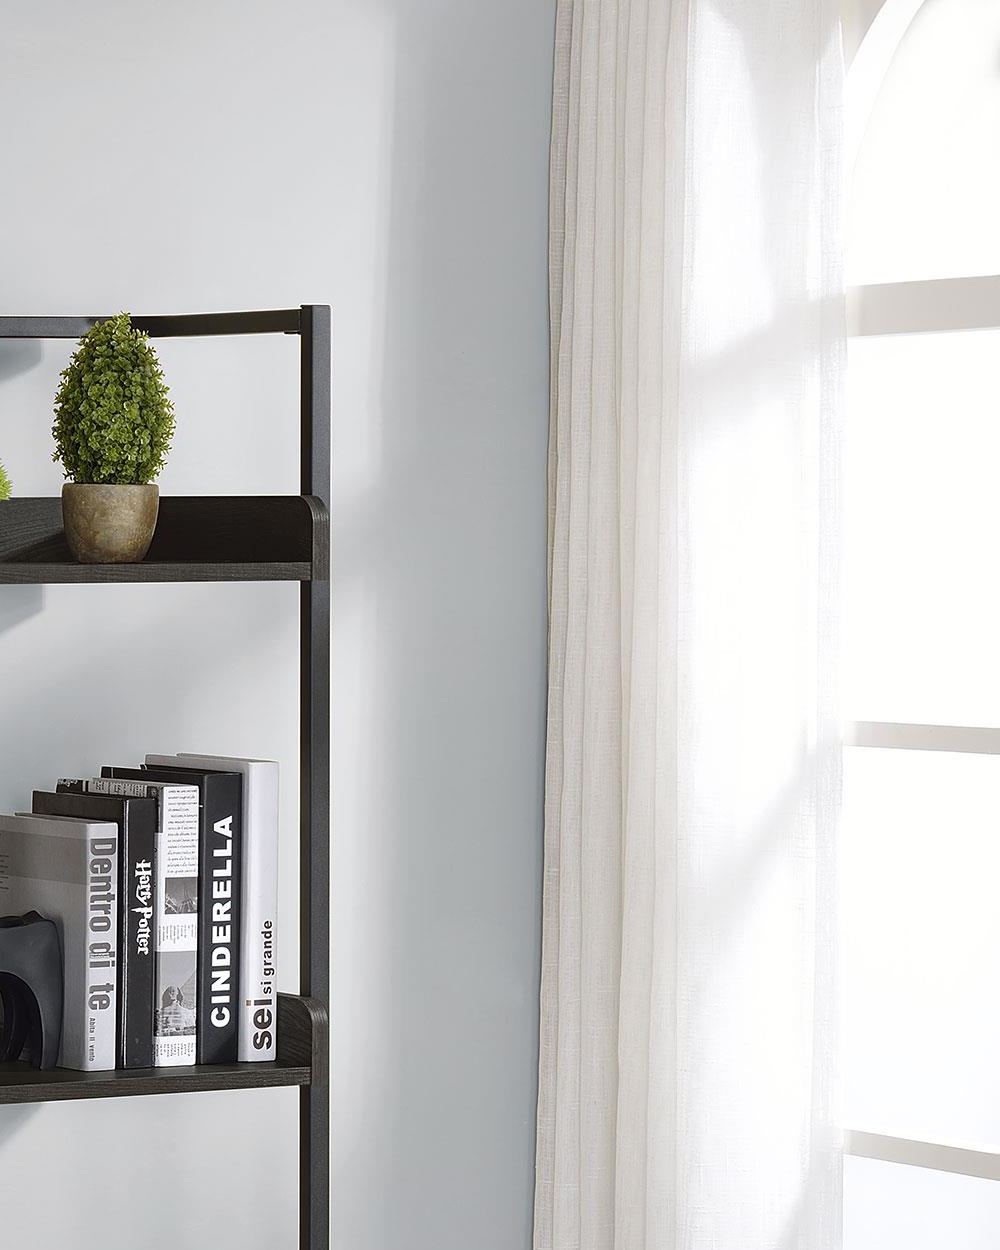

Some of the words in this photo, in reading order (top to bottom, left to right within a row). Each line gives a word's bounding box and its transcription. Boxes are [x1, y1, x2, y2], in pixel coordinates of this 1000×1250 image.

[89, 838, 116, 932] Dentro
[135, 859, 152, 905] Harry
[131, 905, 153, 955] Potter
[211, 815, 233, 1029] CINDERELLA
[88, 942, 115, 968] di
[261, 920, 276, 977] grande
[88, 983, 114, 1010] te
[261, 979, 272, 995] si
[246, 998, 272, 1051] sei
